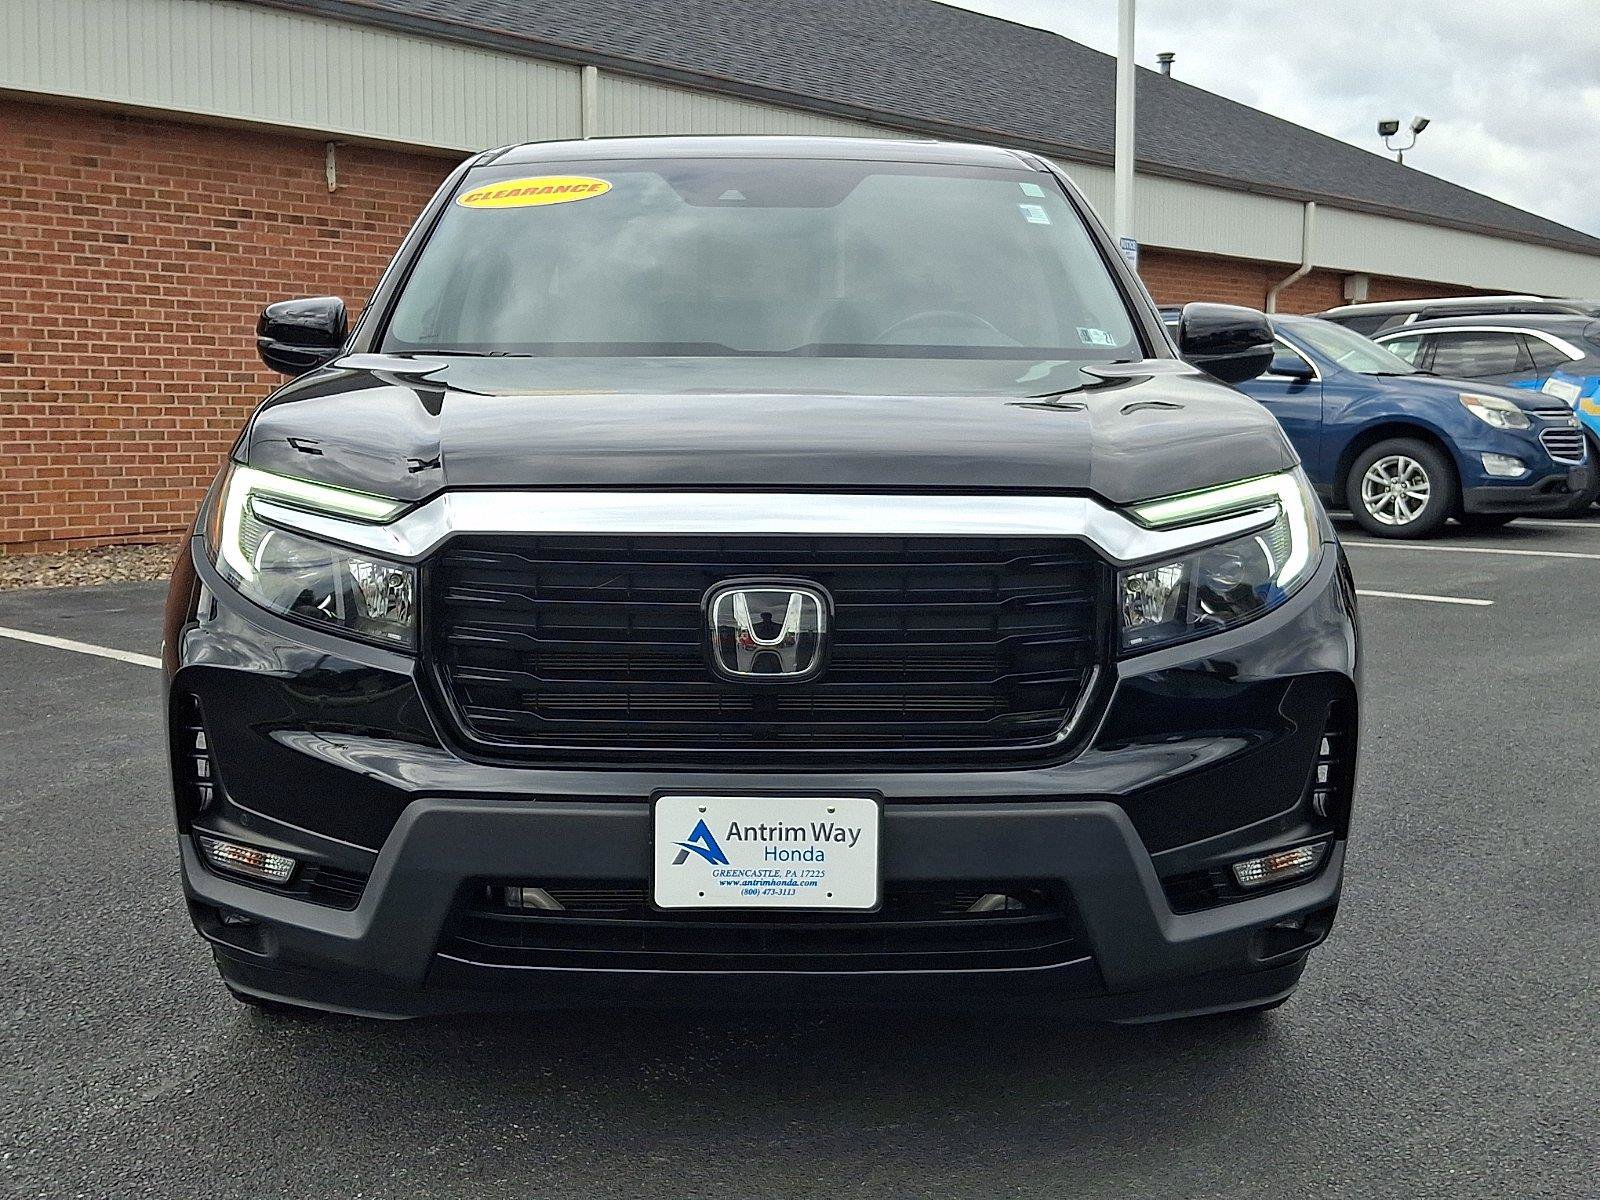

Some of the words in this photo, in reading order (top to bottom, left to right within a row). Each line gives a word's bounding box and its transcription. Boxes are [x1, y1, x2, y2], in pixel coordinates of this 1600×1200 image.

[465, 183, 603, 203] CLEARANCE
[726, 821, 806, 842] Antrim
[810, 822, 861, 848] Way
[764, 846, 825, 862] Honda
[712, 869, 781, 878] GREENCASTLE,
[785, 870, 797, 878] PA
[800, 870, 825, 878] 17225
[719, 878, 818, 887] www.antrimhonda.com
[740, 888, 760, 897] (800)
[762, 888, 796, 896] 473-3113
